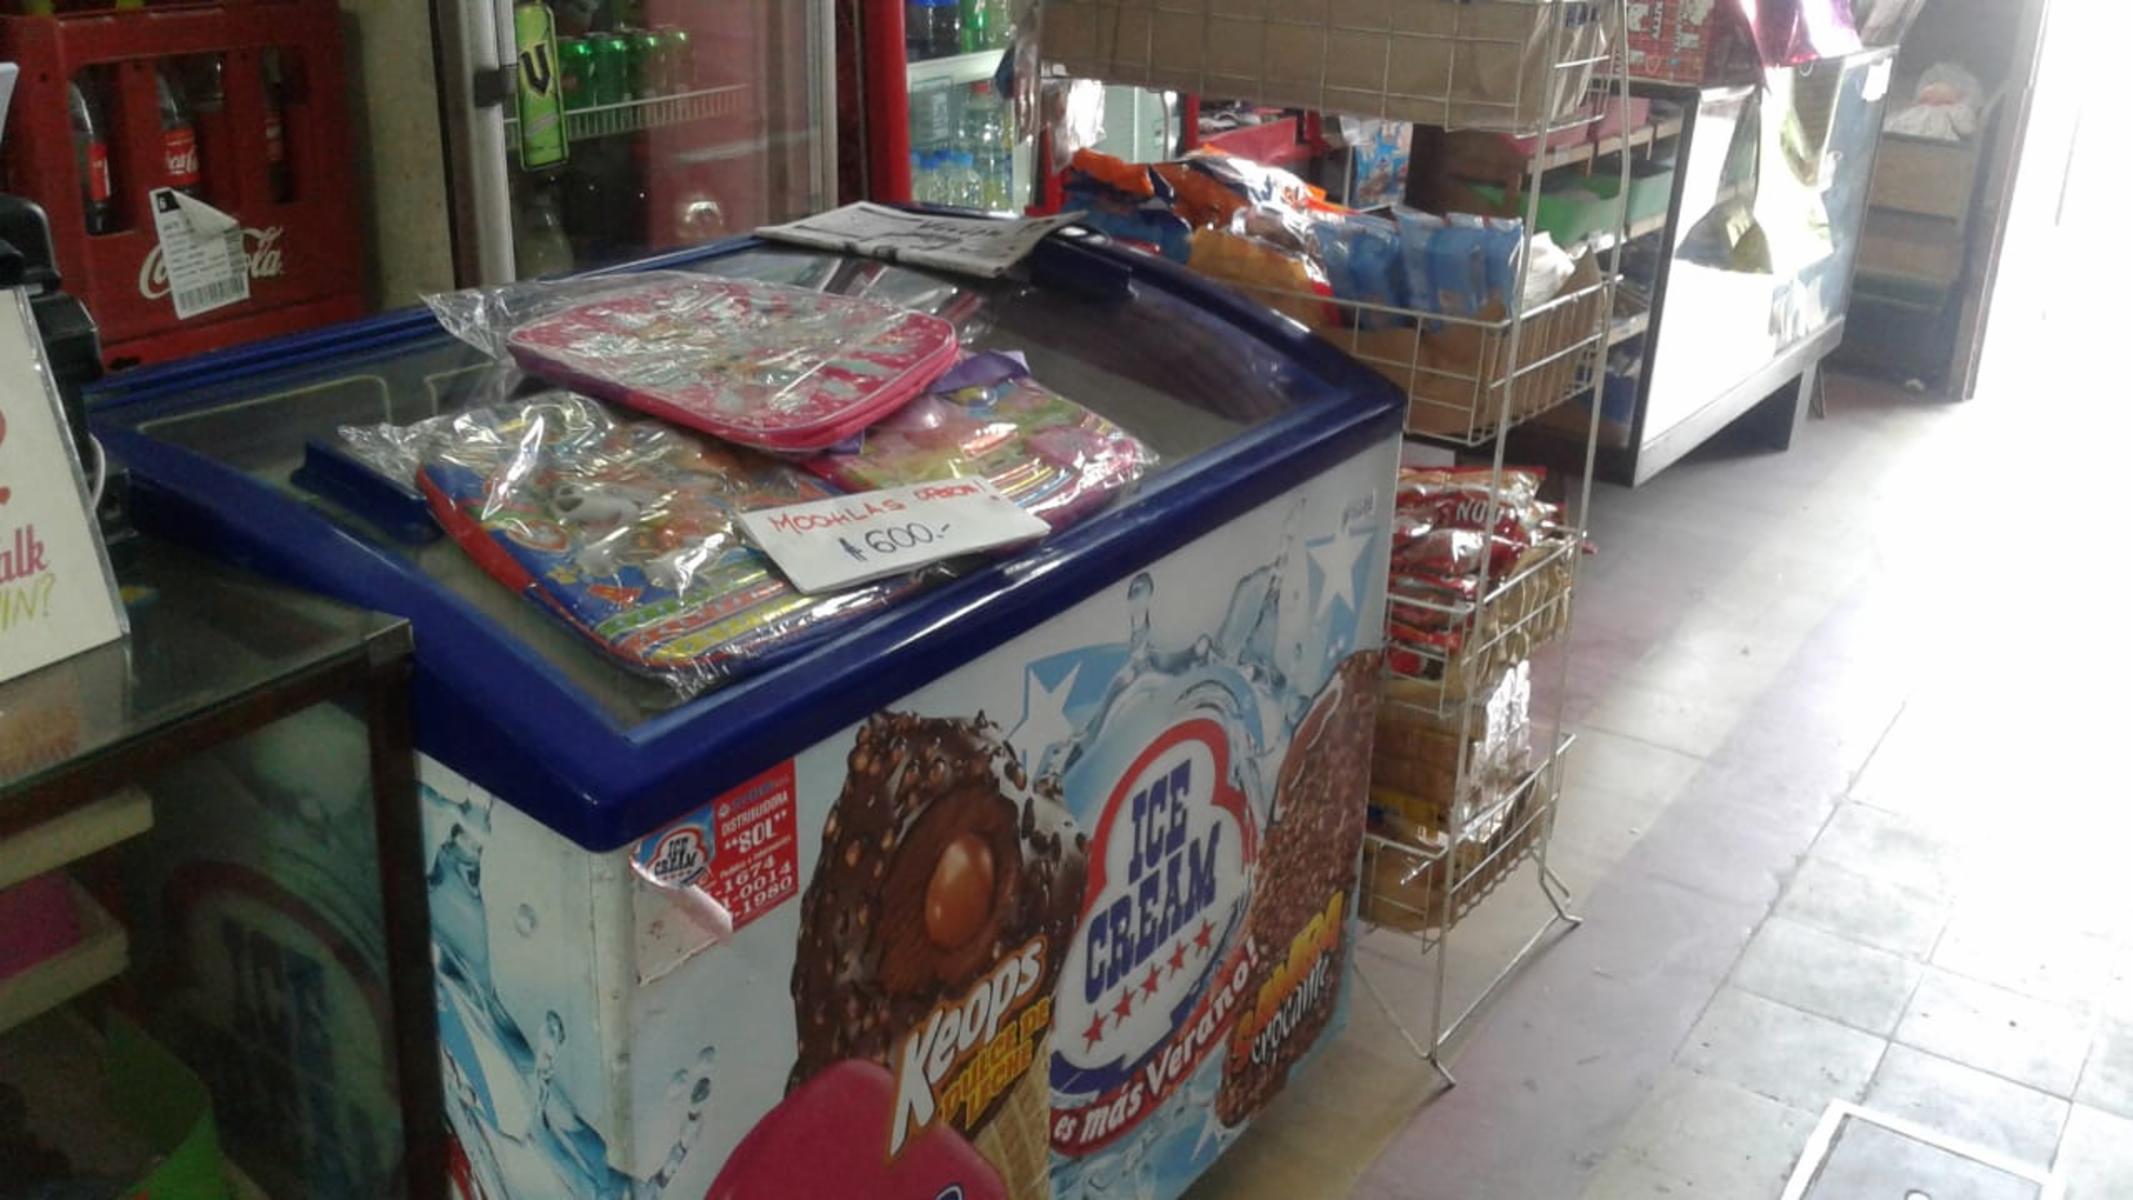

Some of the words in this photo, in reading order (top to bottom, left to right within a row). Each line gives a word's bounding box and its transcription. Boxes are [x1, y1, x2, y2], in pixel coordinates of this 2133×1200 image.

[1084, 821, 1222, 1005] CREAM
[1128, 759, 1192, 886] ICE
[889, 942, 1043, 1157] Keops
[1053, 1112, 1077, 1140] es
[1079, 1081, 1143, 1144] más
[1145, 936, 1261, 1096] Verano!
